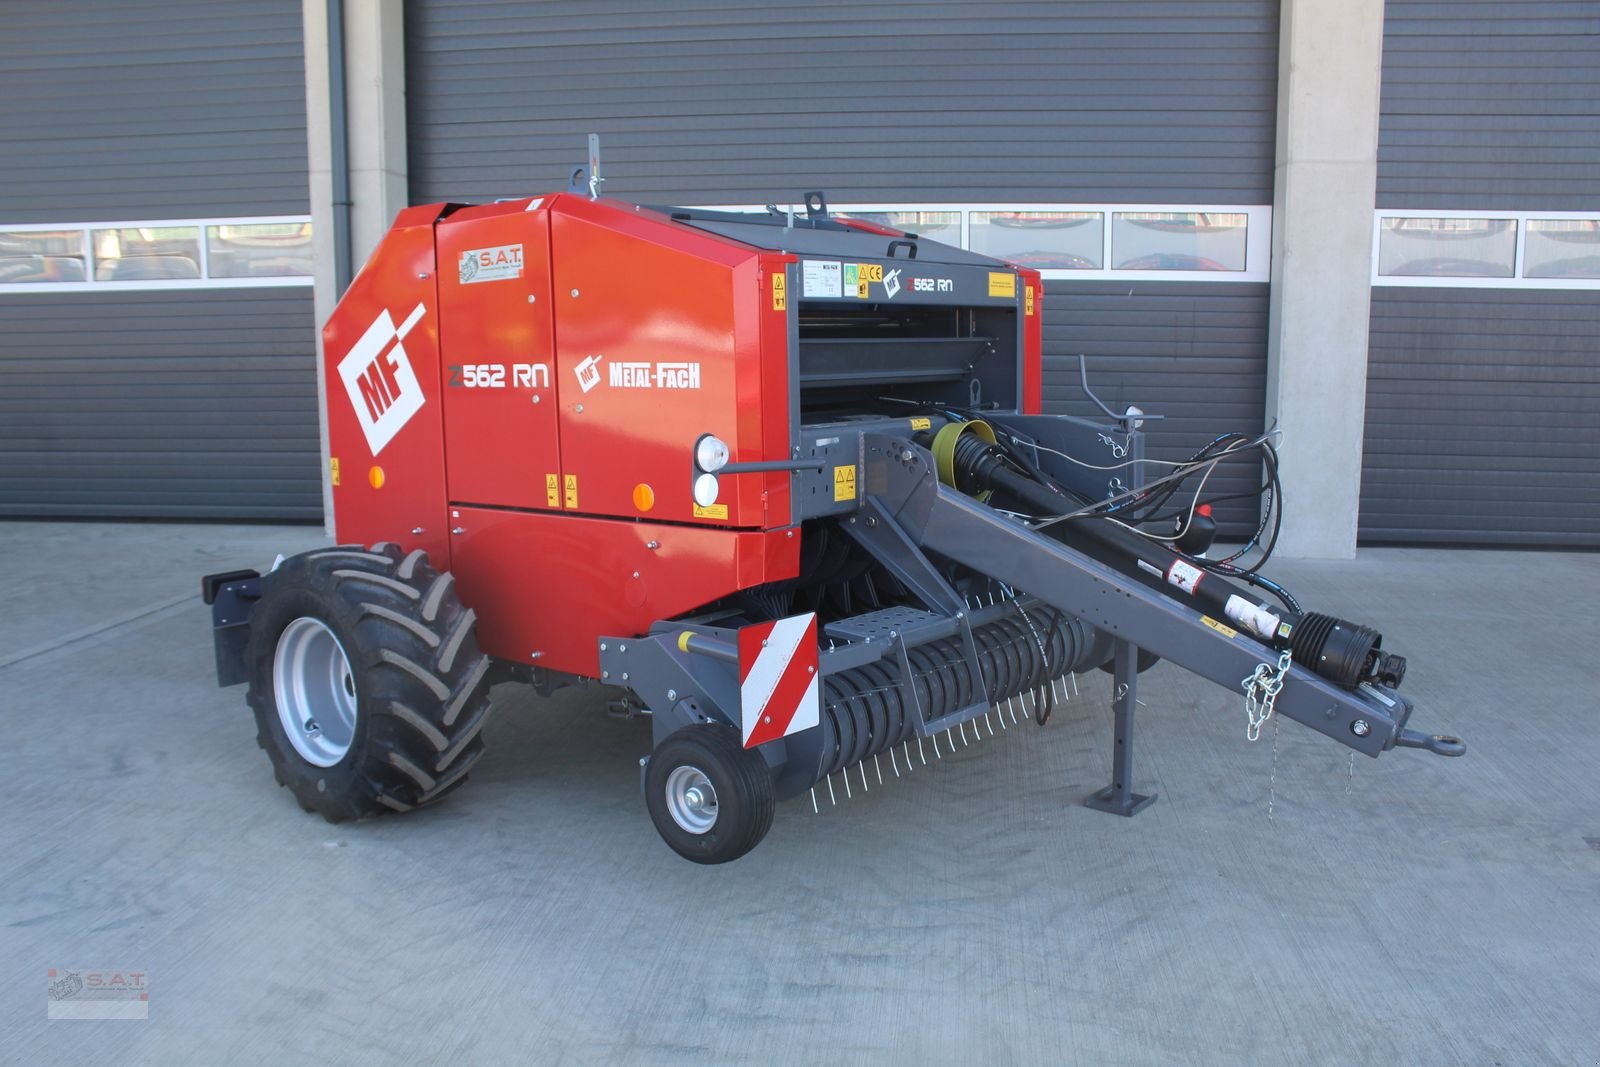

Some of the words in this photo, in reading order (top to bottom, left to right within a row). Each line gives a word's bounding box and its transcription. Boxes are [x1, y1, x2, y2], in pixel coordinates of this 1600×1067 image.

[479, 247, 521, 267] S.A.T.
[907, 278, 935, 292] Z562
[356, 333, 402, 425] MF
[447, 364, 506, 388] Z562
[579, 363, 596, 386] MF
[608, 361, 701, 389] METAL-FACH
